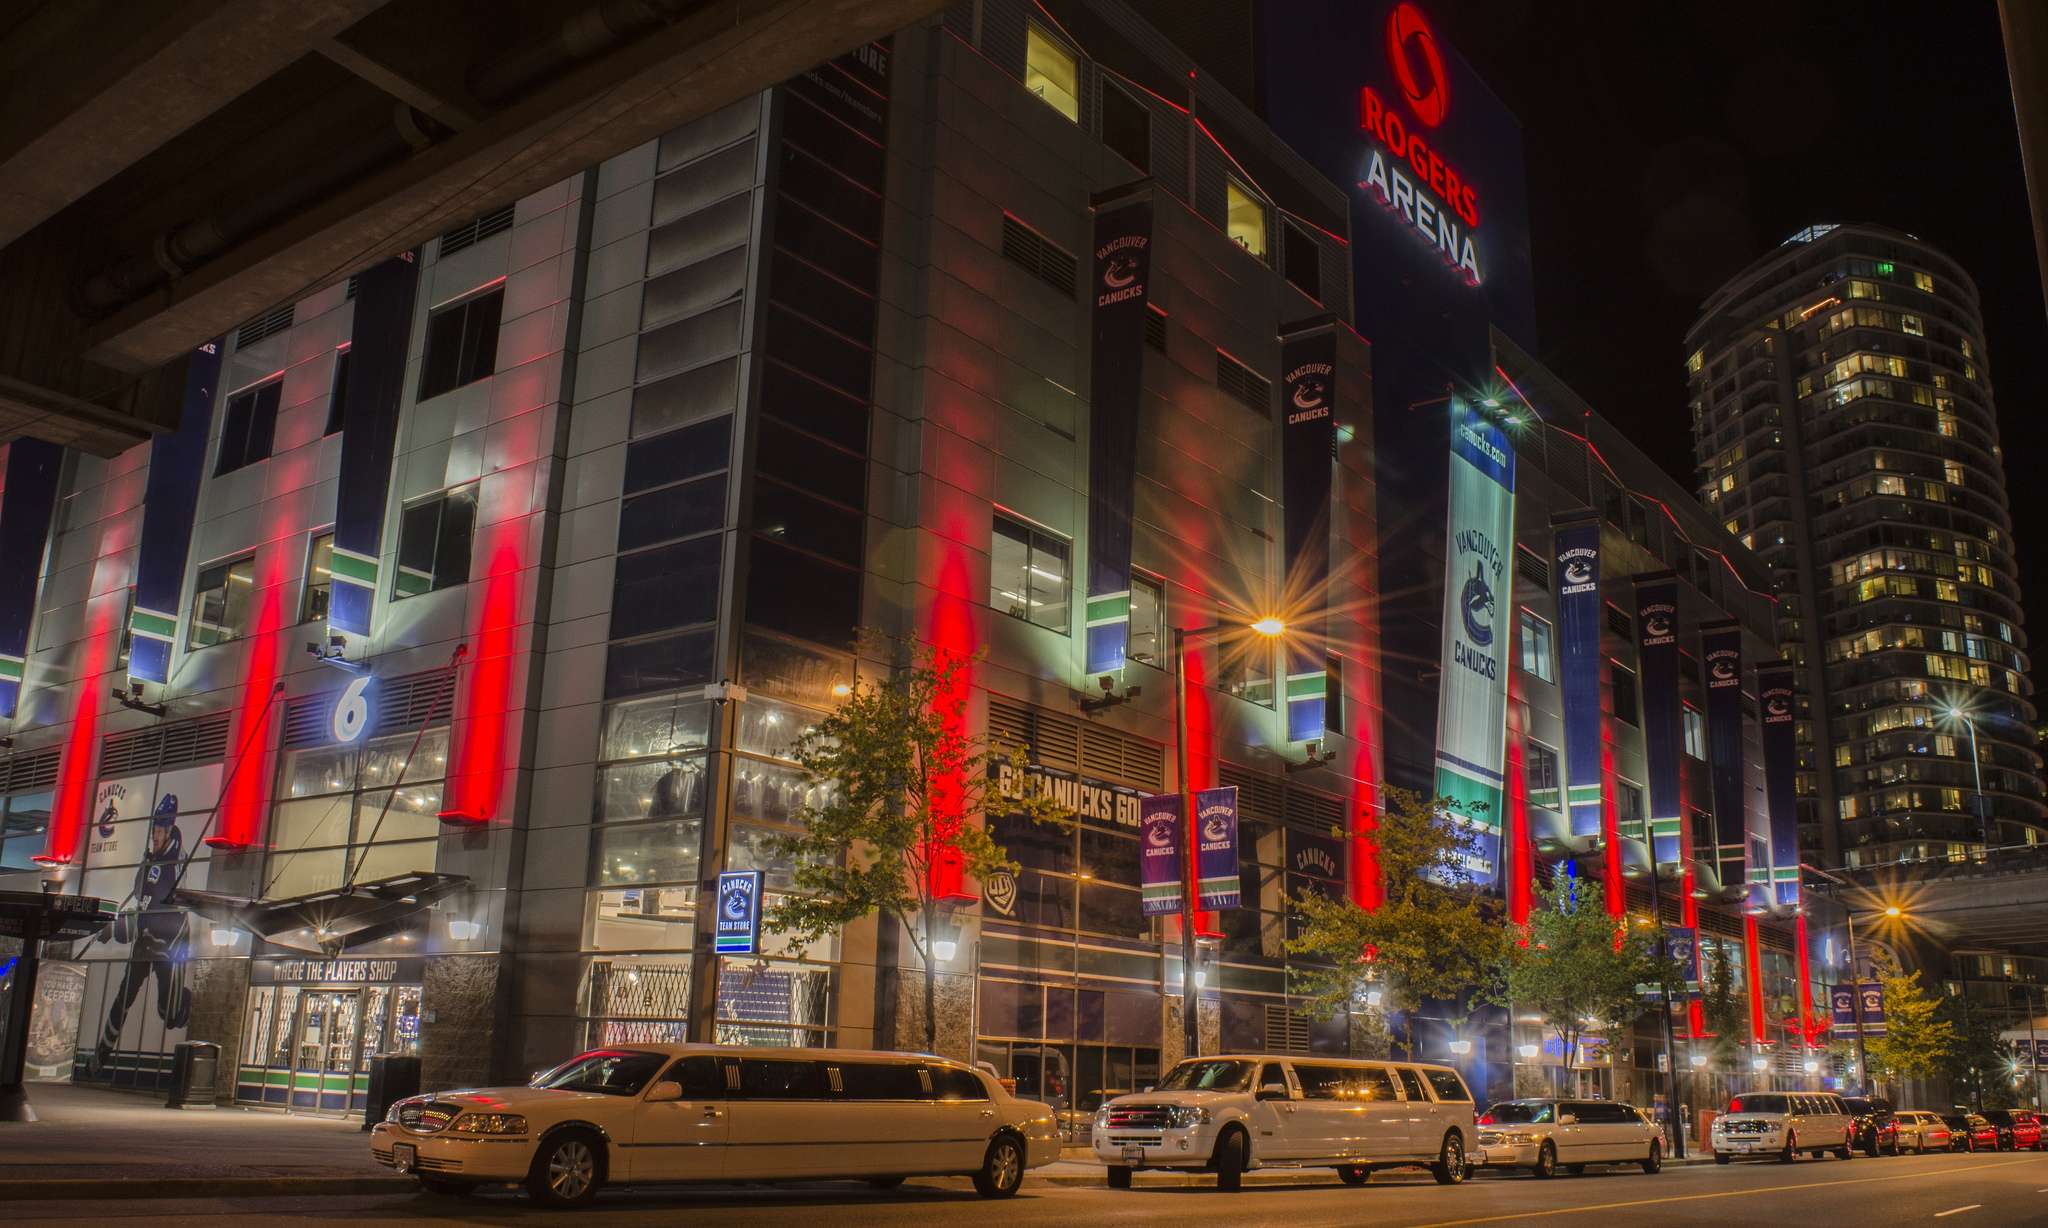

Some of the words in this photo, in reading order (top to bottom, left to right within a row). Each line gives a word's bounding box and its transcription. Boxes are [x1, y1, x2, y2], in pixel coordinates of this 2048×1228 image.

[1361, 86, 1480, 228] ROGERS
[1367, 150, 1482, 284] ARENA
[1096, 236, 1148, 260] VANCOUVER
[1099, 284, 1142, 307] CANUCKS
[1285, 362, 1332, 384] VANCOUVER
[1289, 407, 1329, 425] CANUCKS
[1460, 424, 1506, 468] canucks.com
[1456, 529, 1504, 581] VANCOUVER
[1558, 548, 1597, 563] VANCOUVER
[1562, 582, 1596, 595] CANUCKS
[1455, 639, 1496, 681] CANUCKS
[334, 676, 371, 742] 6
[99, 783, 127, 803] CANUCKS
[1116, 794, 1142, 828] GO!
[1144, 811, 1176, 825] VANCOUVER
[1199, 805, 1234, 819] VANCOUVER
[1145, 846, 1175, 857] CANUCKS
[1201, 840, 1231, 851] CANUCKS
[1296, 847, 1336, 877] CANUCKS
[722, 879, 752, 895] CANUCKS
[720, 921, 733, 931] TEAM
[733, 920, 750, 931] STORE
[272, 961, 305, 981] WHERE
[306, 961, 323, 980] THE
[325, 960, 367, 981] PLAYERS
[368, 961, 397, 981] SHOP
